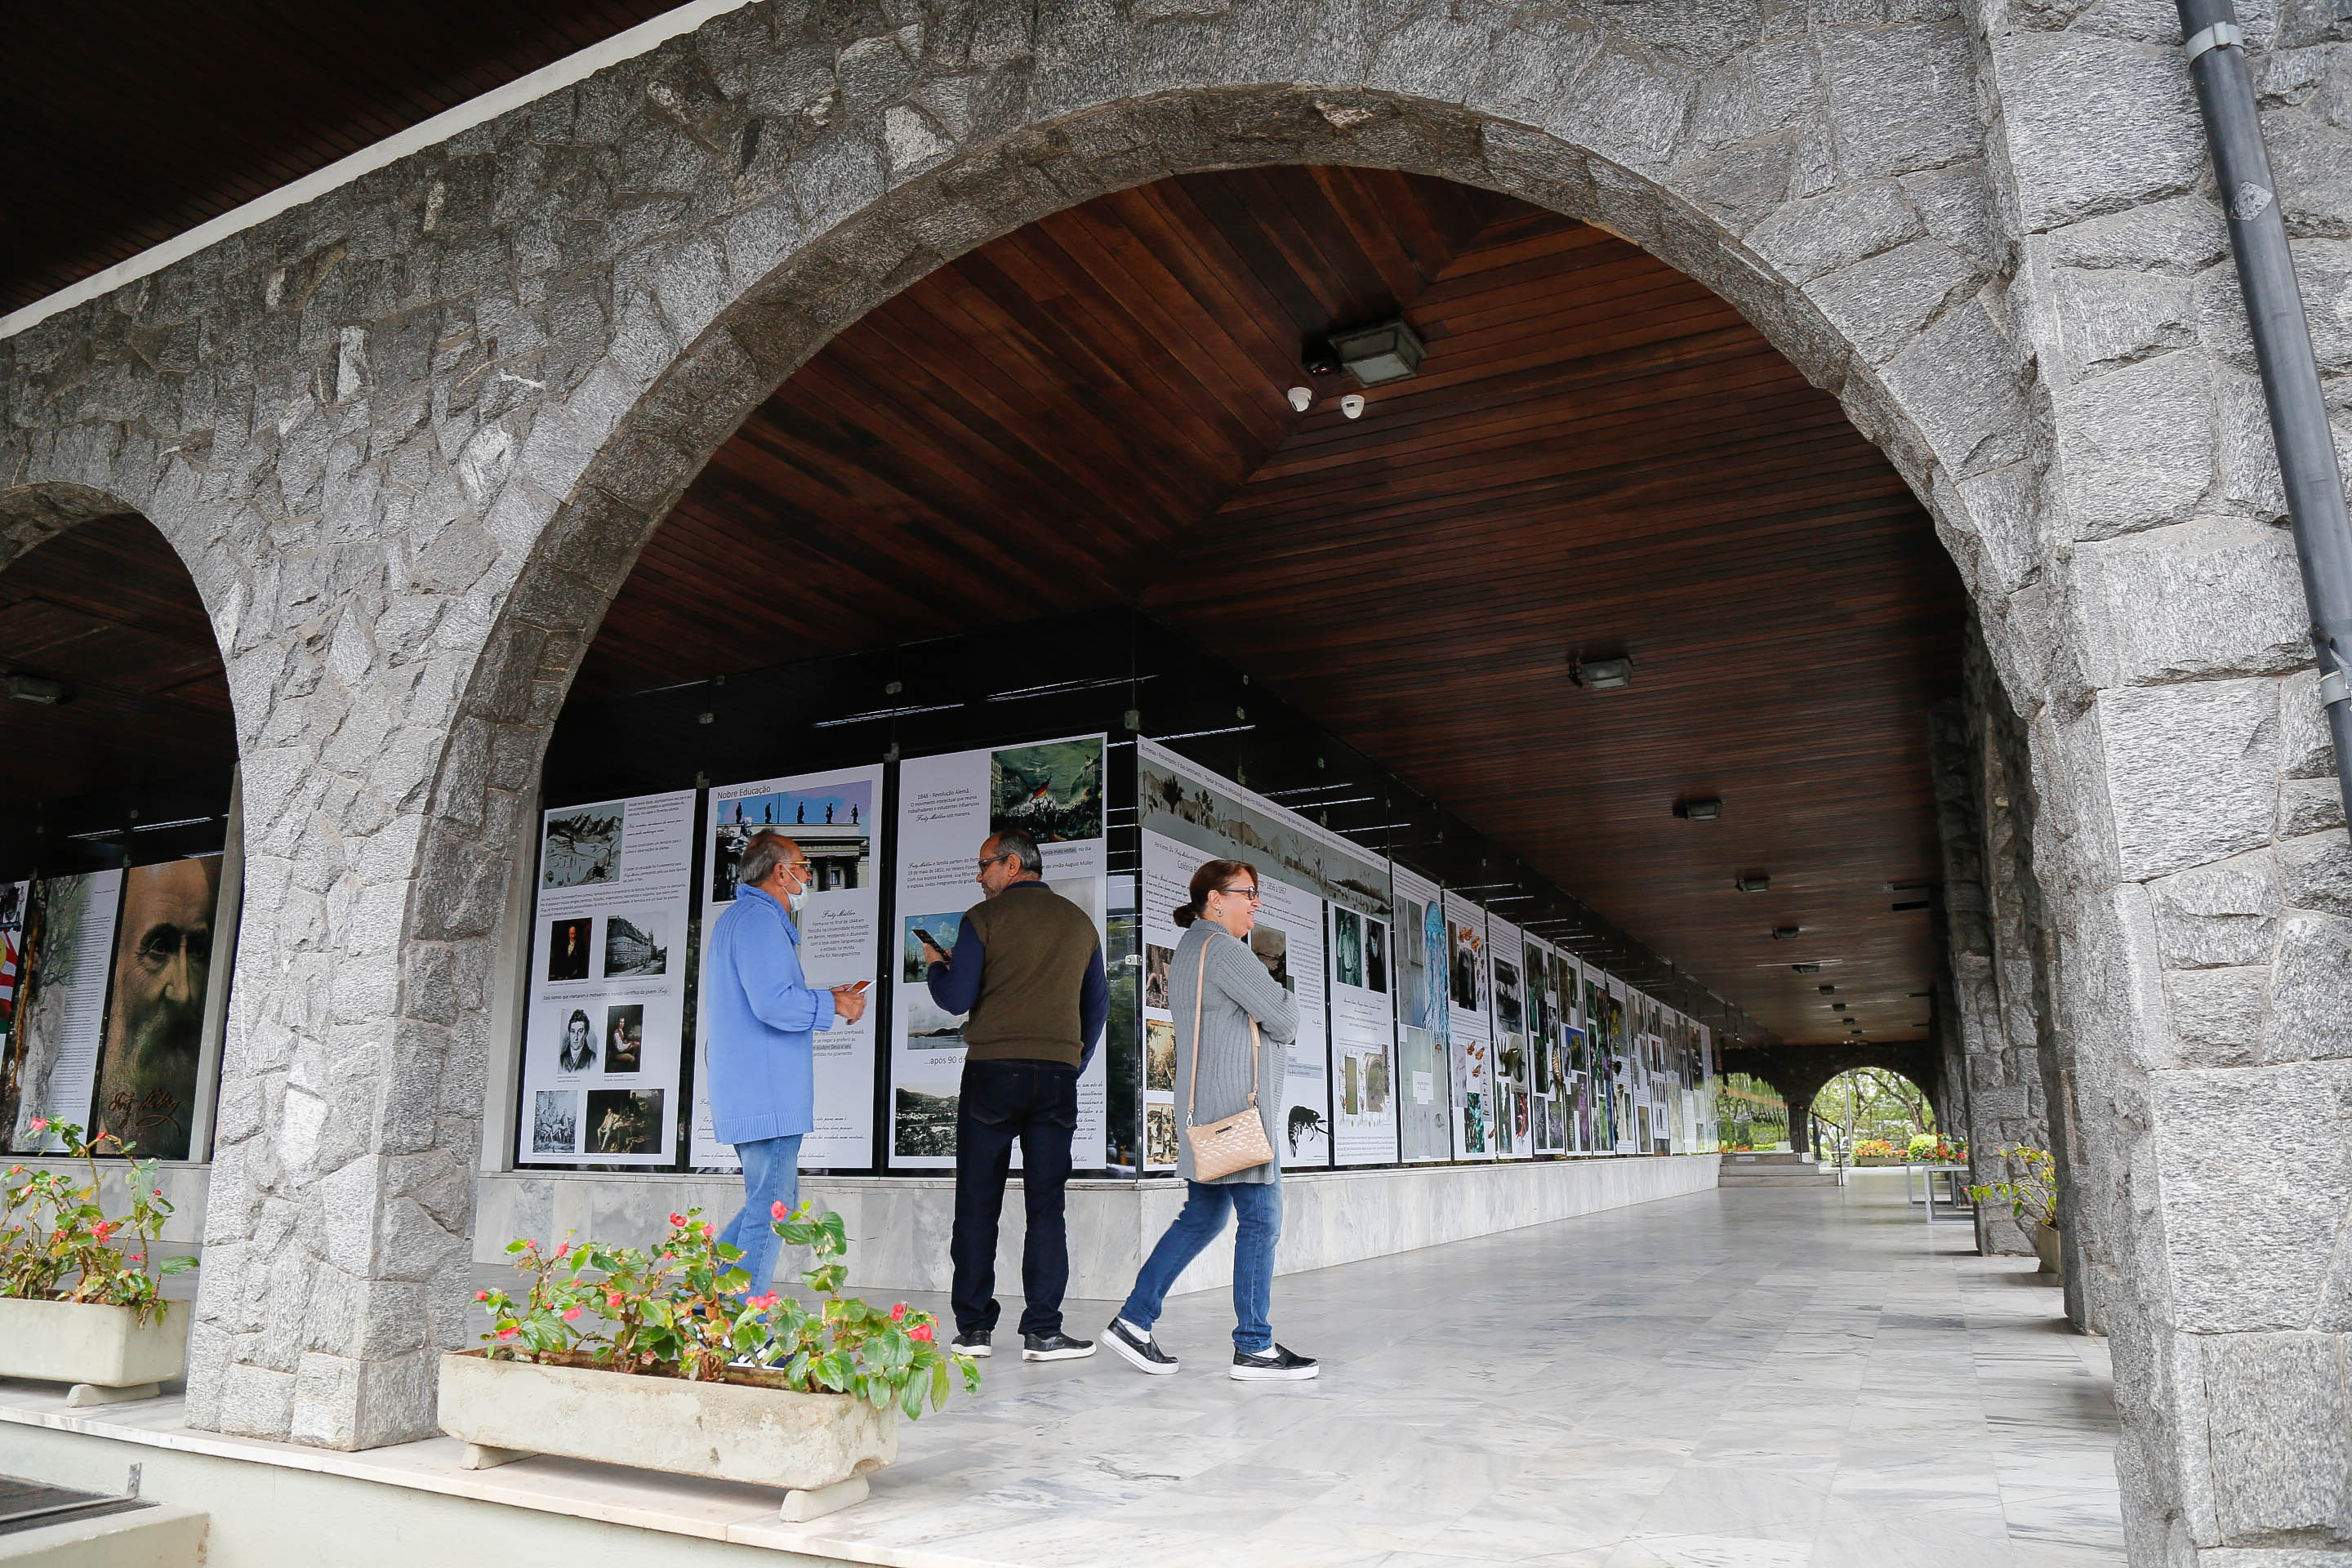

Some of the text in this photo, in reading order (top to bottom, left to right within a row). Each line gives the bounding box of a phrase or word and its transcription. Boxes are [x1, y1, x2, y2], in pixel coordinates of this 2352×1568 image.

[718, 785, 771, 800] Nobre Educação
[947, 1056, 957, 1064] 90
